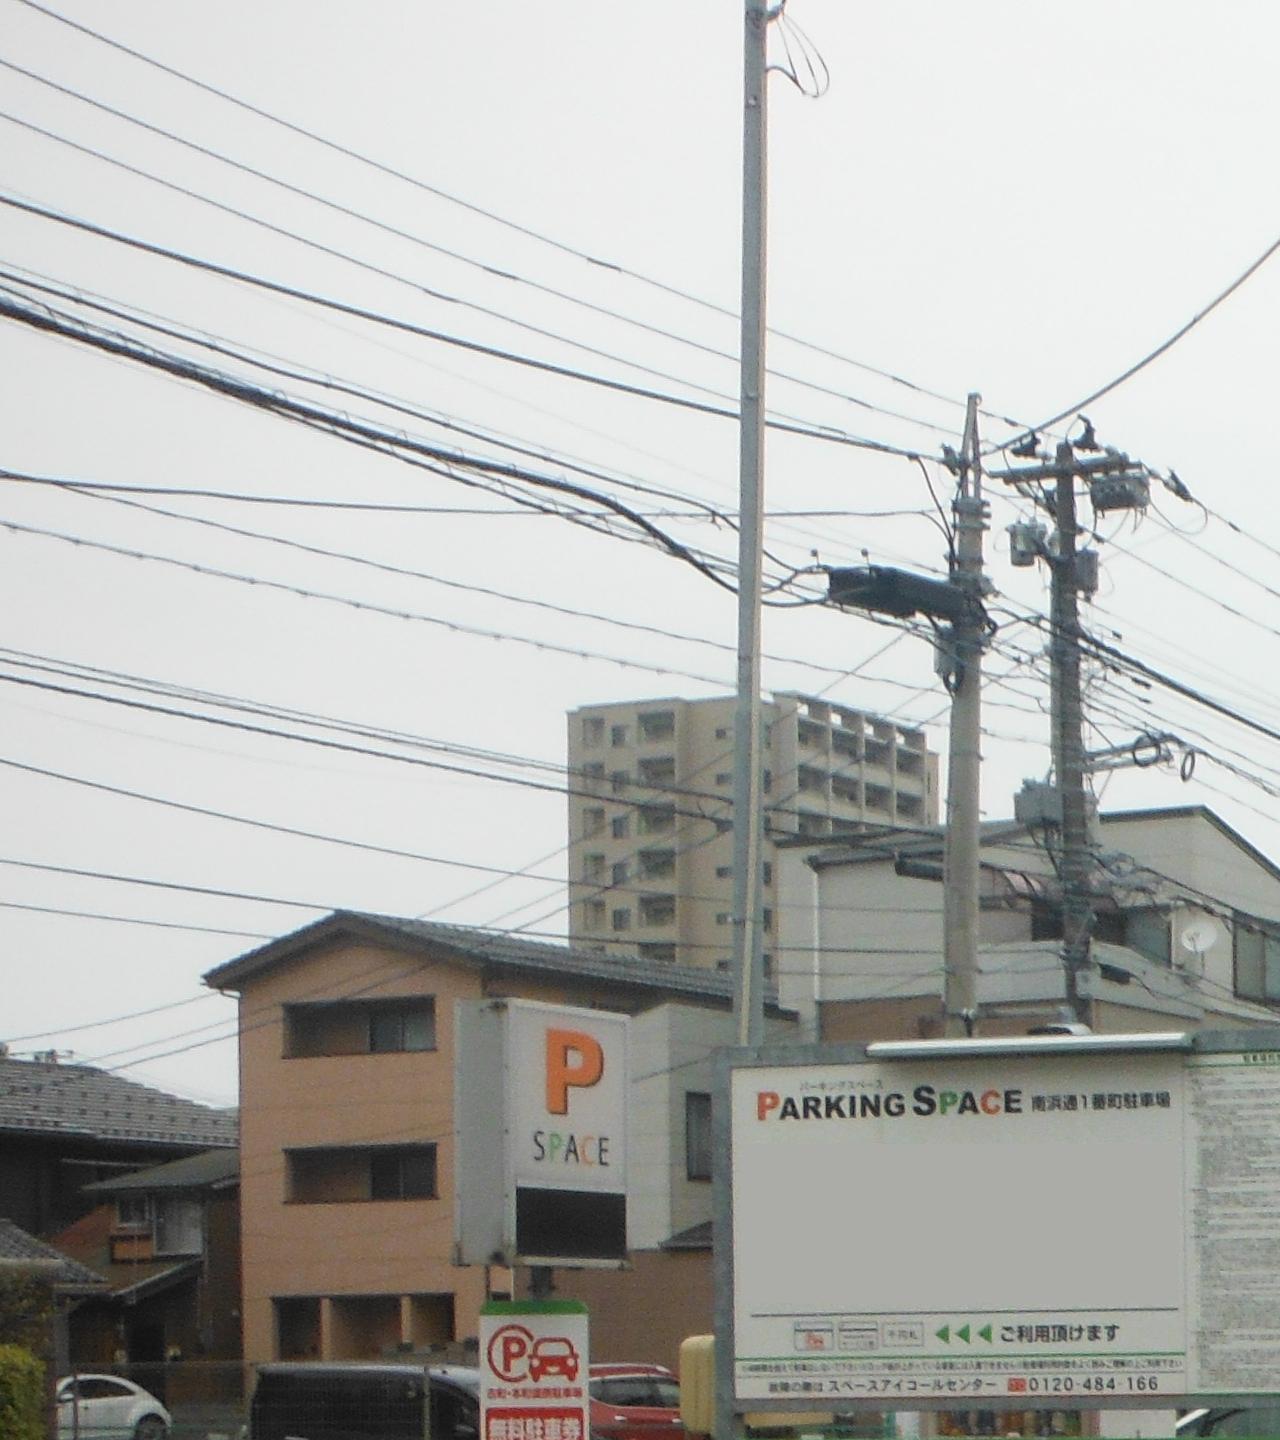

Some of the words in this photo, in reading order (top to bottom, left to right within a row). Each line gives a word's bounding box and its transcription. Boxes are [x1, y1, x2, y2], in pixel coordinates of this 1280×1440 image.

[546, 1028, 604, 1115] P
[757, 1092, 905, 1121] PARKING
[912, 1085, 1023, 1116] SPACE
[533, 1131, 610, 1167] SPACE
[1000, 1324, 1121, 1344] ご利用頂けます
[502, 1336, 527, 1373] P
[1029, 1375, 1158, 1392] 0120-484-166
